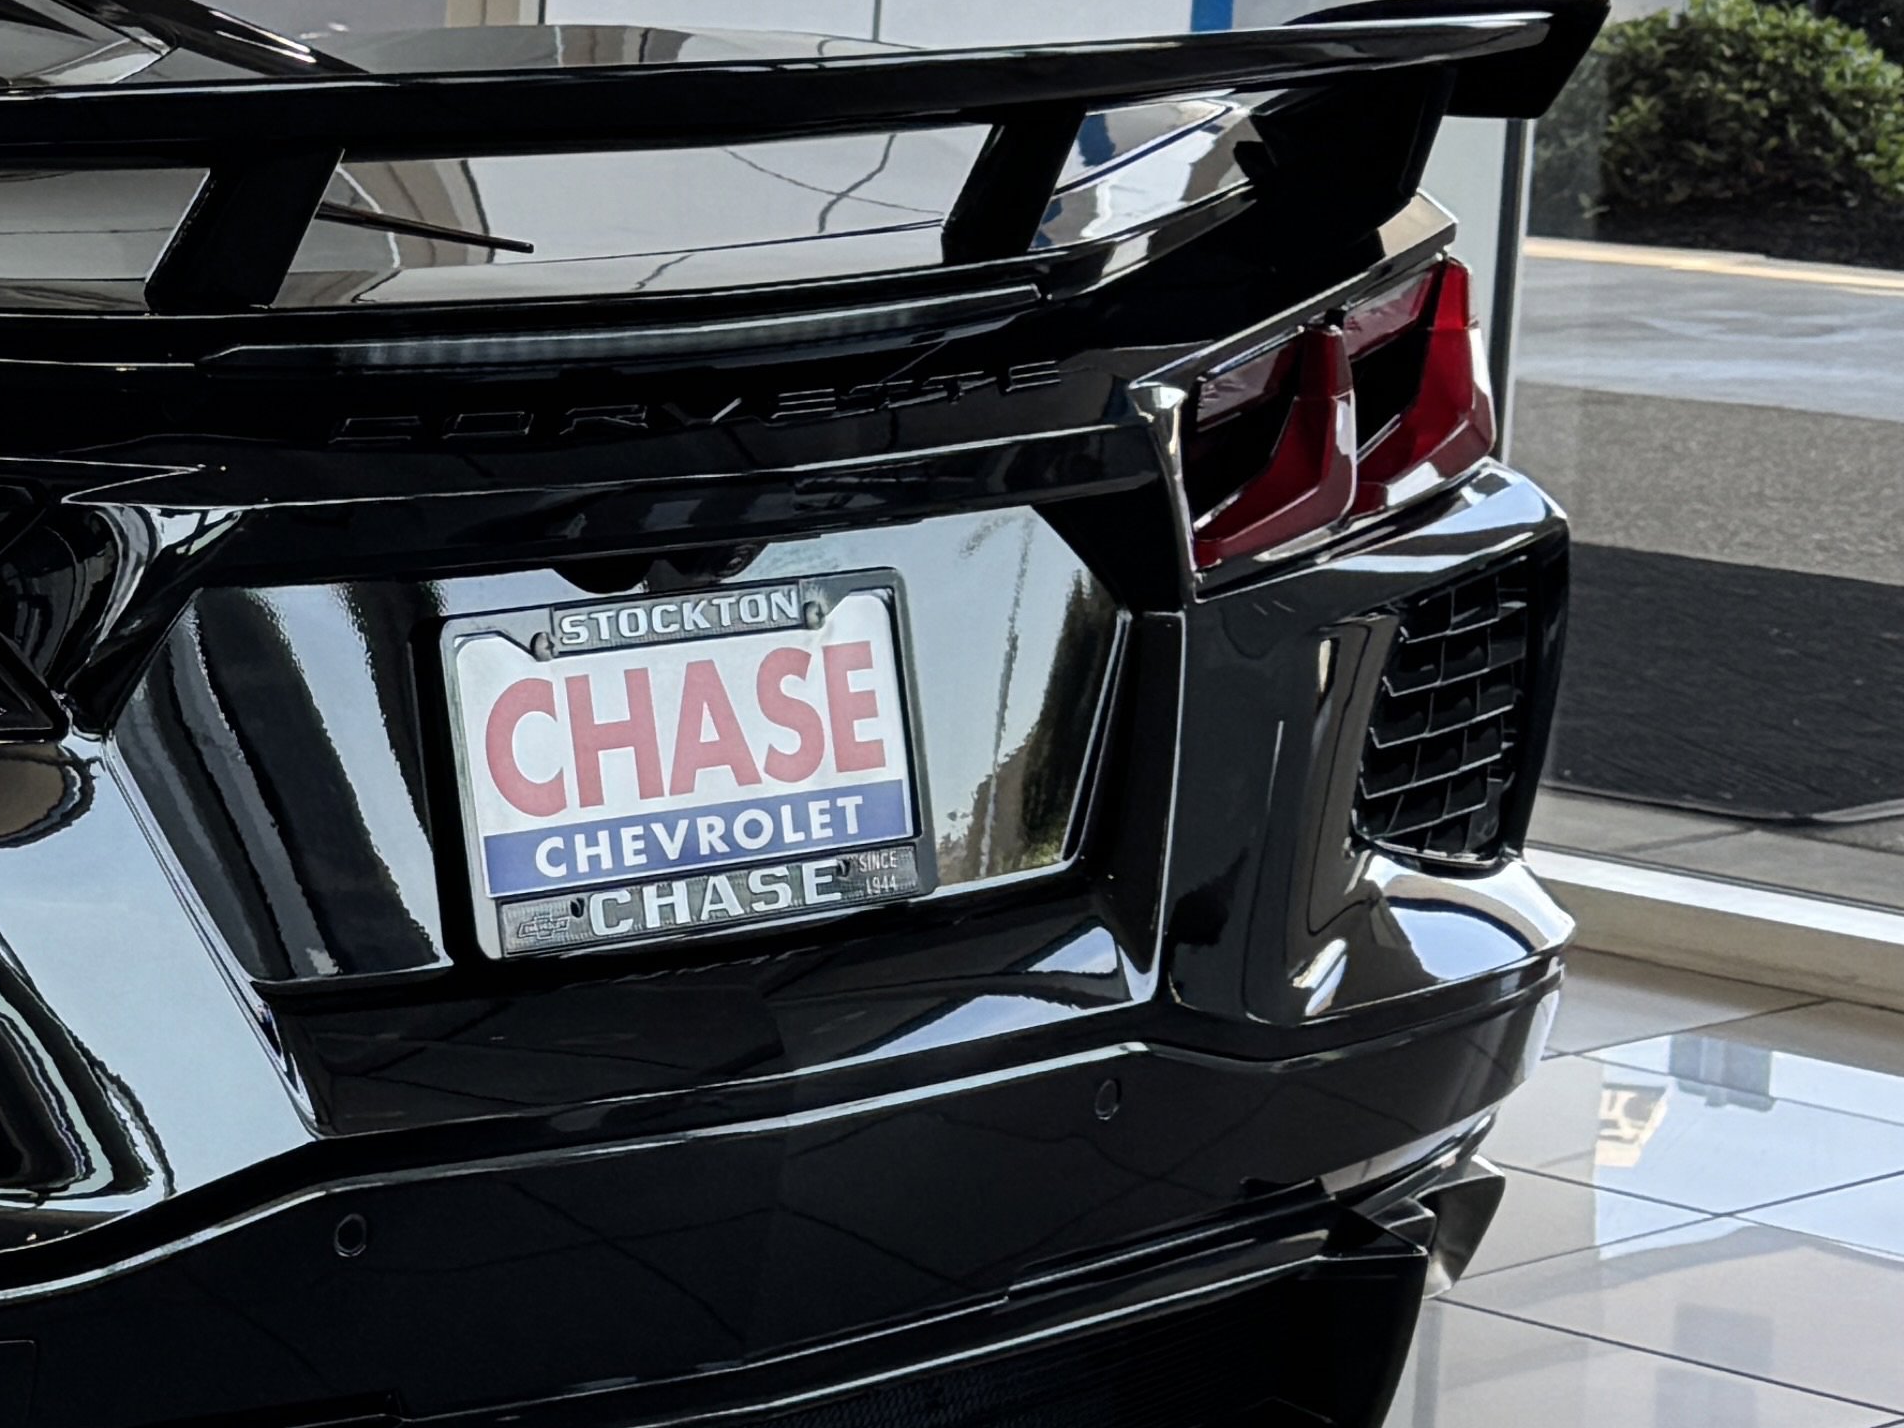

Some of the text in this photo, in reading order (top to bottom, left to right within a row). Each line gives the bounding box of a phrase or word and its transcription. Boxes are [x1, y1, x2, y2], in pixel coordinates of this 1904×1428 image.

[328, 361, 1061, 444] CORVETTE
[560, 591, 798, 646] STOCKTON
[484, 640, 887, 818] CHASE
[535, 795, 865, 878] CHEVROLET
[859, 849, 898, 871] SINCE
[589, 858, 844, 937] CHASE
[865, 875, 897, 897] 1944
